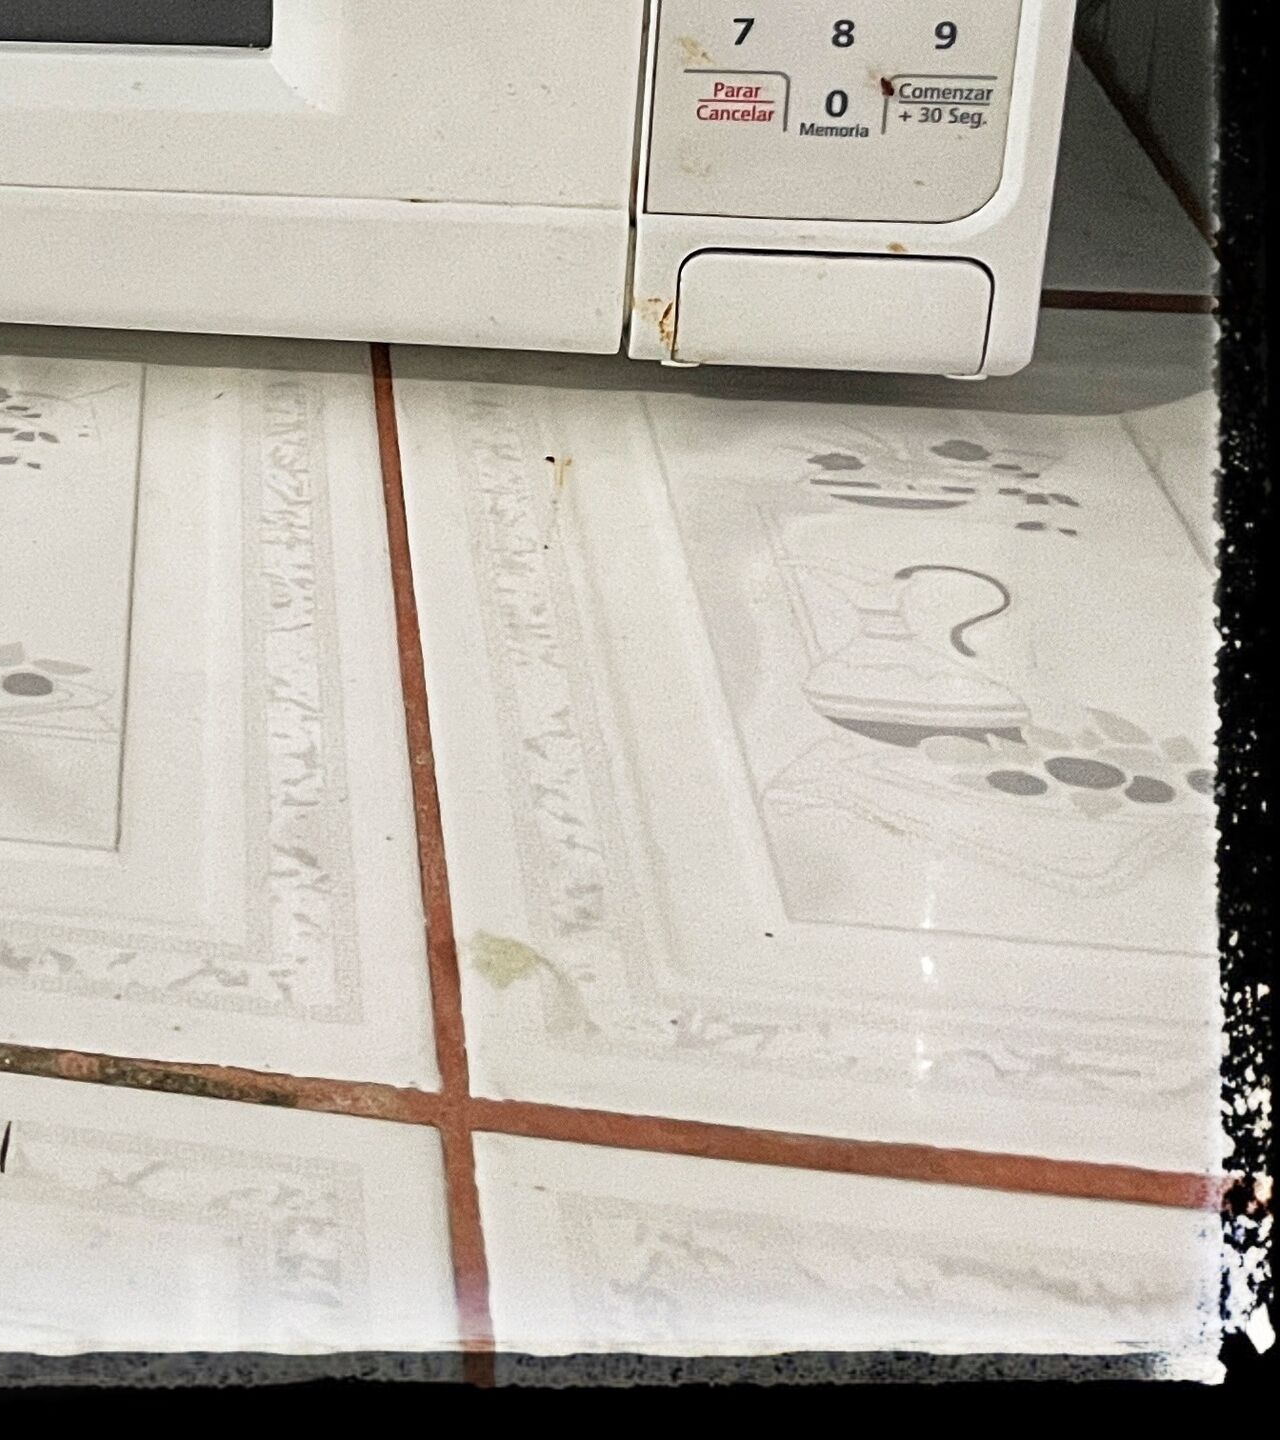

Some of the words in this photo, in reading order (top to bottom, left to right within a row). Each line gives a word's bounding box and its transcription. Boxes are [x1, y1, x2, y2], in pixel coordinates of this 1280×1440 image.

[733, 17, 756, 46] 7
[831, 19, 856, 49] 8
[934, 20, 959, 51] 9
[713, 82, 761, 98] Parar
[898, 83, 994, 101] Comenzar
[825, 89, 849, 118] 0
[696, 105, 775, 123] Cancelar
[918, 107, 942, 123] 30
[948, 108, 988, 127] Seg.
[800, 122, 869, 138] Memoria
